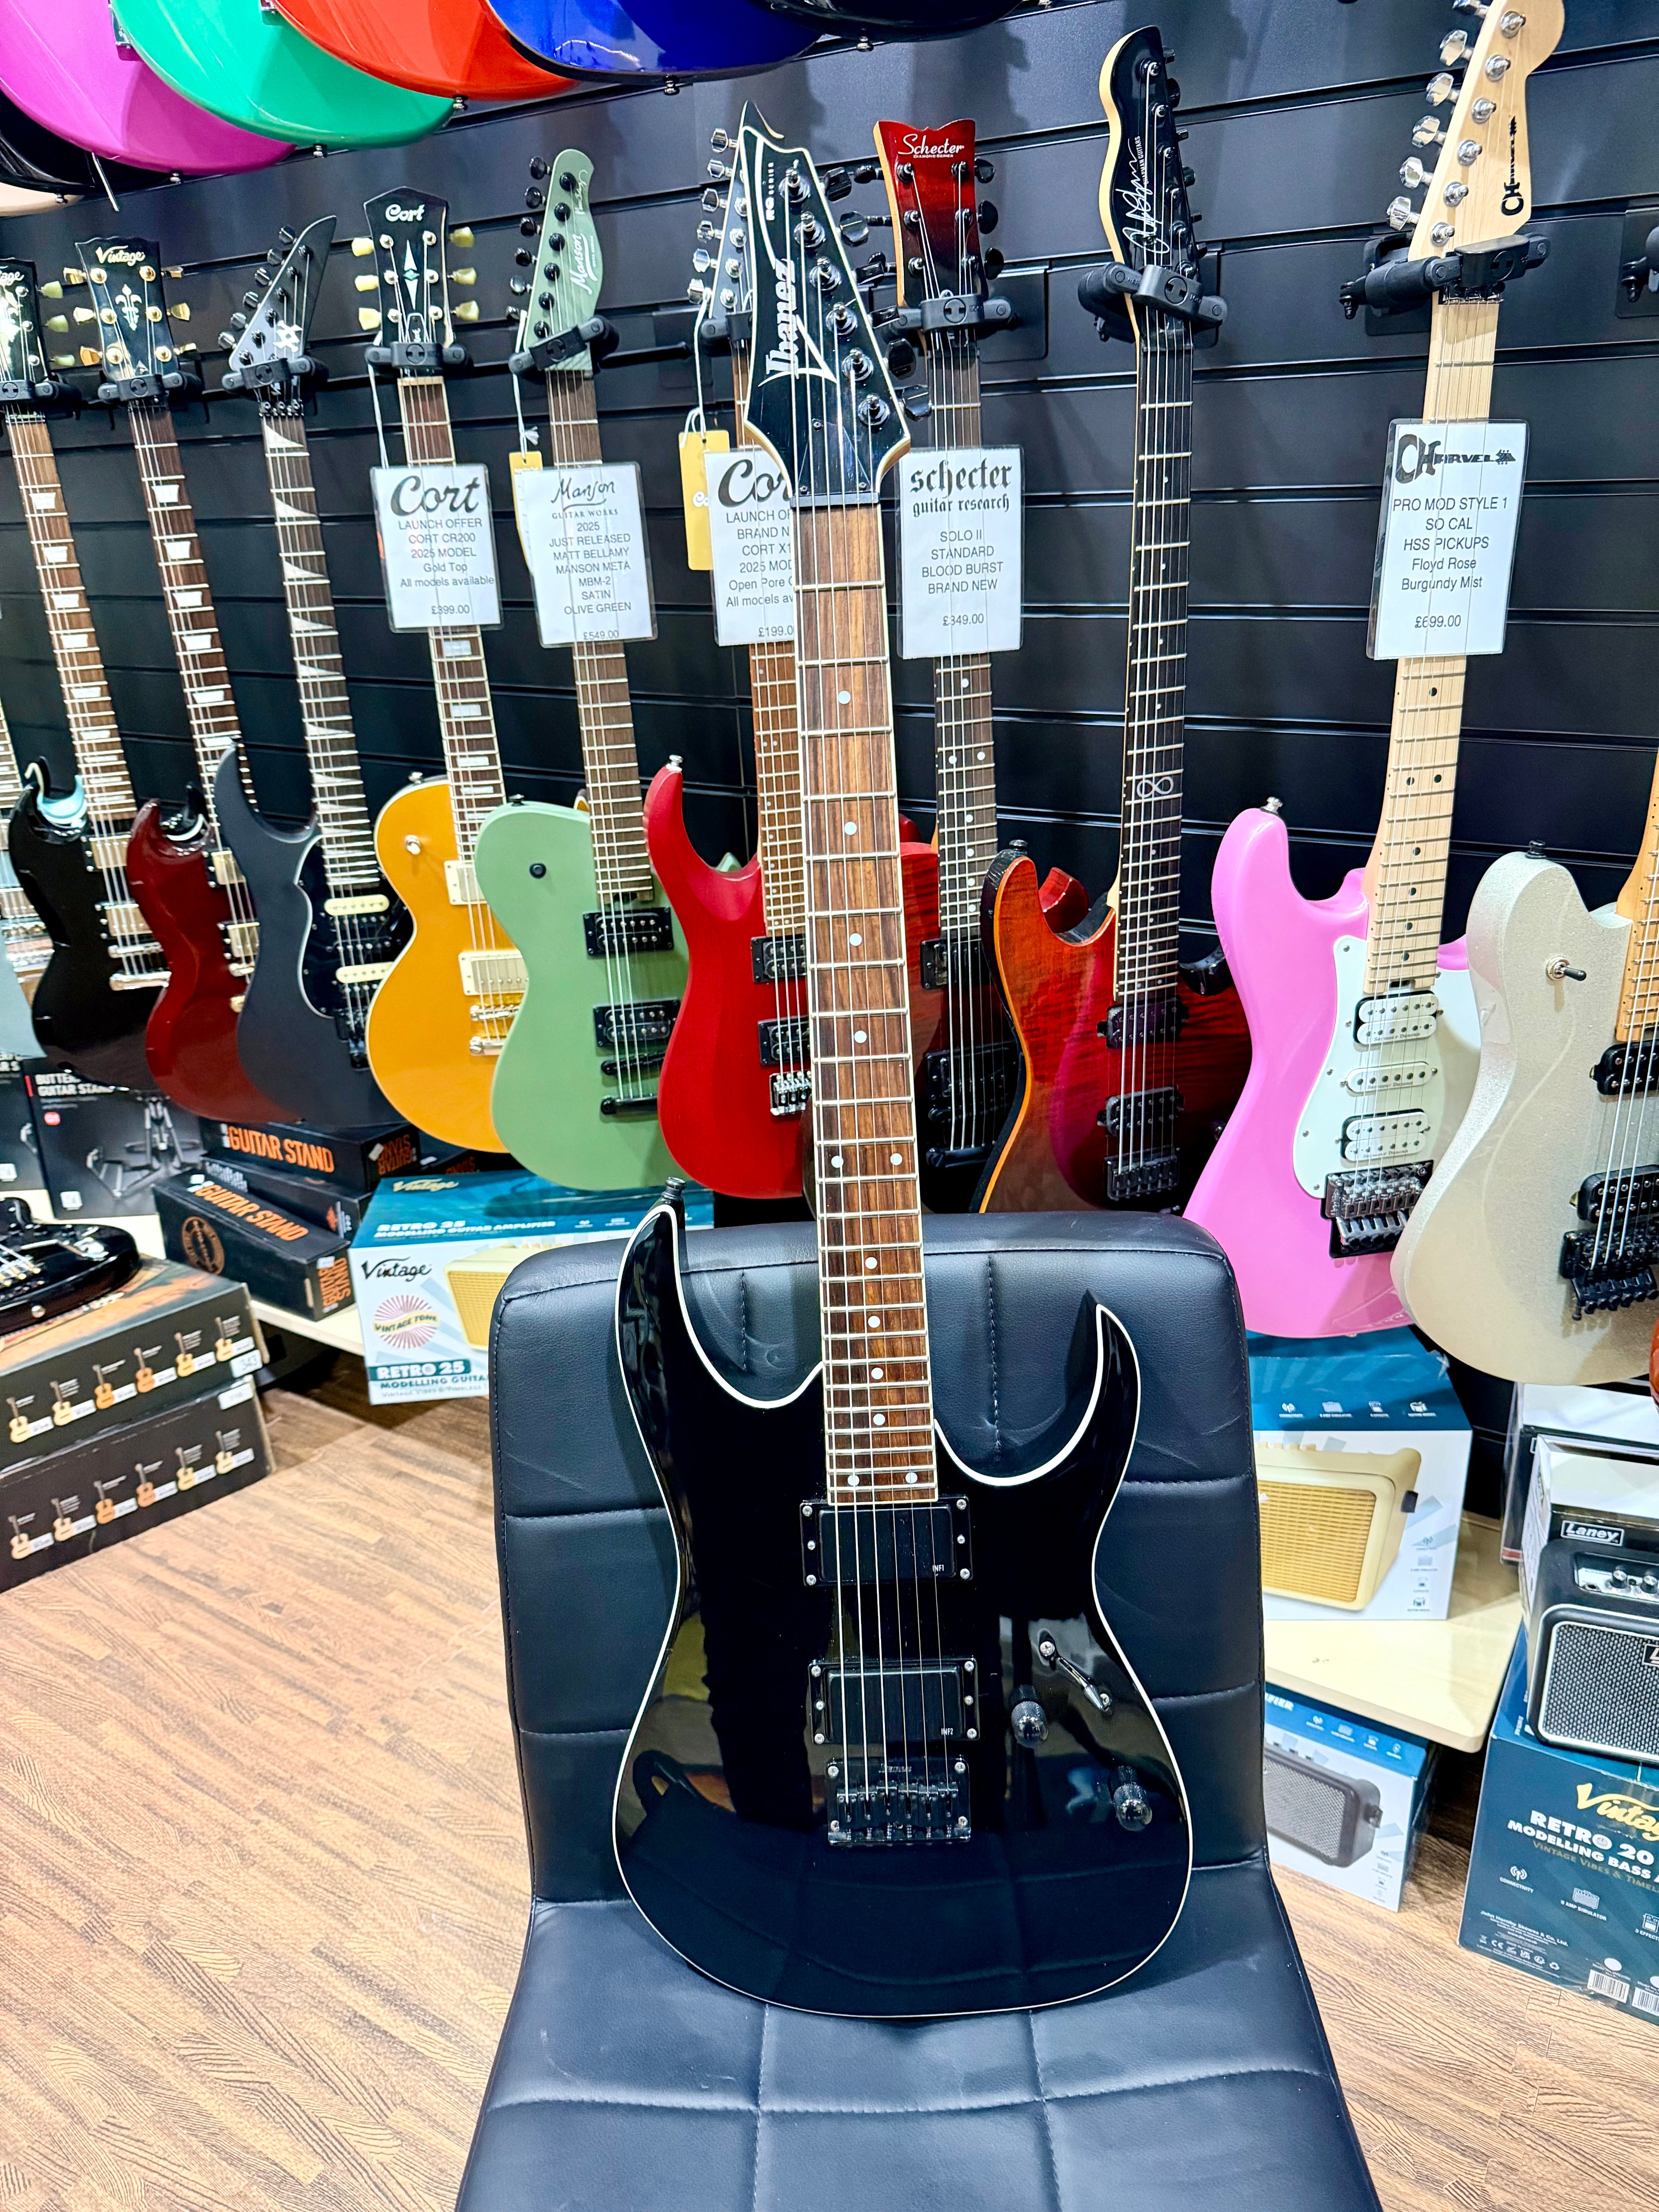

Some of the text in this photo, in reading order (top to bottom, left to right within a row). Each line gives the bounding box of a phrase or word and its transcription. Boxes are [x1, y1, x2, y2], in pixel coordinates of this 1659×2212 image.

[898, 134, 963, 155] Schecter
[1134, 136, 1144, 159] GUITARS
[386, 204, 425, 222] Cort
[96, 246, 145, 266] Vintage
[569, 234, 592, 295] Manson
[766, 258, 799, 379] Ibanez
[910, 458, 1012, 497] schecter
[391, 476, 480, 516] Cort
[551, 477, 616, 503] Manson
[913, 493, 1009, 517] guitar research
[1393, 497, 1507, 511] PRO MOD STYLE 1
[552, 508, 618, 519] GUITAR WORKS
[726, 511, 775, 523] LAUNCH
[398, 517, 483, 530] LAUNCH OFFER
[577, 522, 599, 532] 2025
[1425, 517, 1473, 530] SO CAL
[408, 532, 476, 544] CORT CR200
[549, 533, 631, 548] JUST RELEASED
[738, 527, 778, 539] BRAND
[940, 529, 982, 542] SOLO II
[742, 544, 775, 556] CORT
[1403, 536, 1489, 551] HSS PICKUPS
[411, 548, 477, 559] 2025 MODEL
[554, 547, 629, 561] MATT BELLAMY
[931, 546, 994, 560] STANDARD
[423, 563, 467, 574] Gold Top
[556, 561, 631, 575] MANSON META
[740, 562, 766, 573] 2025
[922, 562, 1003, 578] BLOOD BURST
[1412, 558, 1476, 573] Floyd Rose
[400, 578, 412, 587] All
[452, 575, 494, 586] available
[579, 576, 611, 587] MBM-2
[729, 580, 757, 592] Open
[761, 577, 785, 589] Pore
[929, 579, 997, 594] BRAND NEW
[1401, 576, 1482, 592] Burgundy Mist
[582, 590, 611, 600] SATIN
[726, 597, 738, 608] All
[564, 602, 632, 615] OLIVE GREEN
[1414, 615, 1461, 628] £699.00
[584, 630, 619, 640] £549.00
[758, 627, 793, 637] £199.0
[39, 1084, 77, 1097] GUITAR
[228, 1125, 283, 1161] GUITAR
[283, 1138, 335, 1173] STAND
[393, 1178, 459, 1192] Vintage
[194, 1184, 260, 1217] GUITAR
[246, 1210, 309, 1241] STAND
[374, 1228, 446, 1238] MODELLING
[447, 1225, 492, 1233] GUITAR
[493, 1221, 556, 1230] AMPLIFIER
[377, 1222, 438, 1232] RETRO
[361, 1256, 432, 1282] Vintage
[374, 1314, 437, 1331] VINTAGE TONE
[376, 1360, 465, 1380] RETRO 25
[380, 1374, 488, 1389] MODELLING GUITA
[1565, 1522, 1619, 1542] Laney
[1577, 1783, 1659, 1841] Vintag
[1530, 1810, 1654, 1866] RETRO 20
[1508, 1820, 1651, 1879] MODELLING BASS
[1533, 1840, 1577, 1863] VINTAGE
[1580, 1857, 1610, 1875] VIBES
[1626, 1875, 1659, 1893] TIMEL
[1499, 1877, 1534, 1893] CONNECTIVITY
[1480, 1910, 1495, 1919] John
[1577, 1906, 1607, 1921] SIMULATOR
[1640, 1930, 1659, 1941] EFFECT
